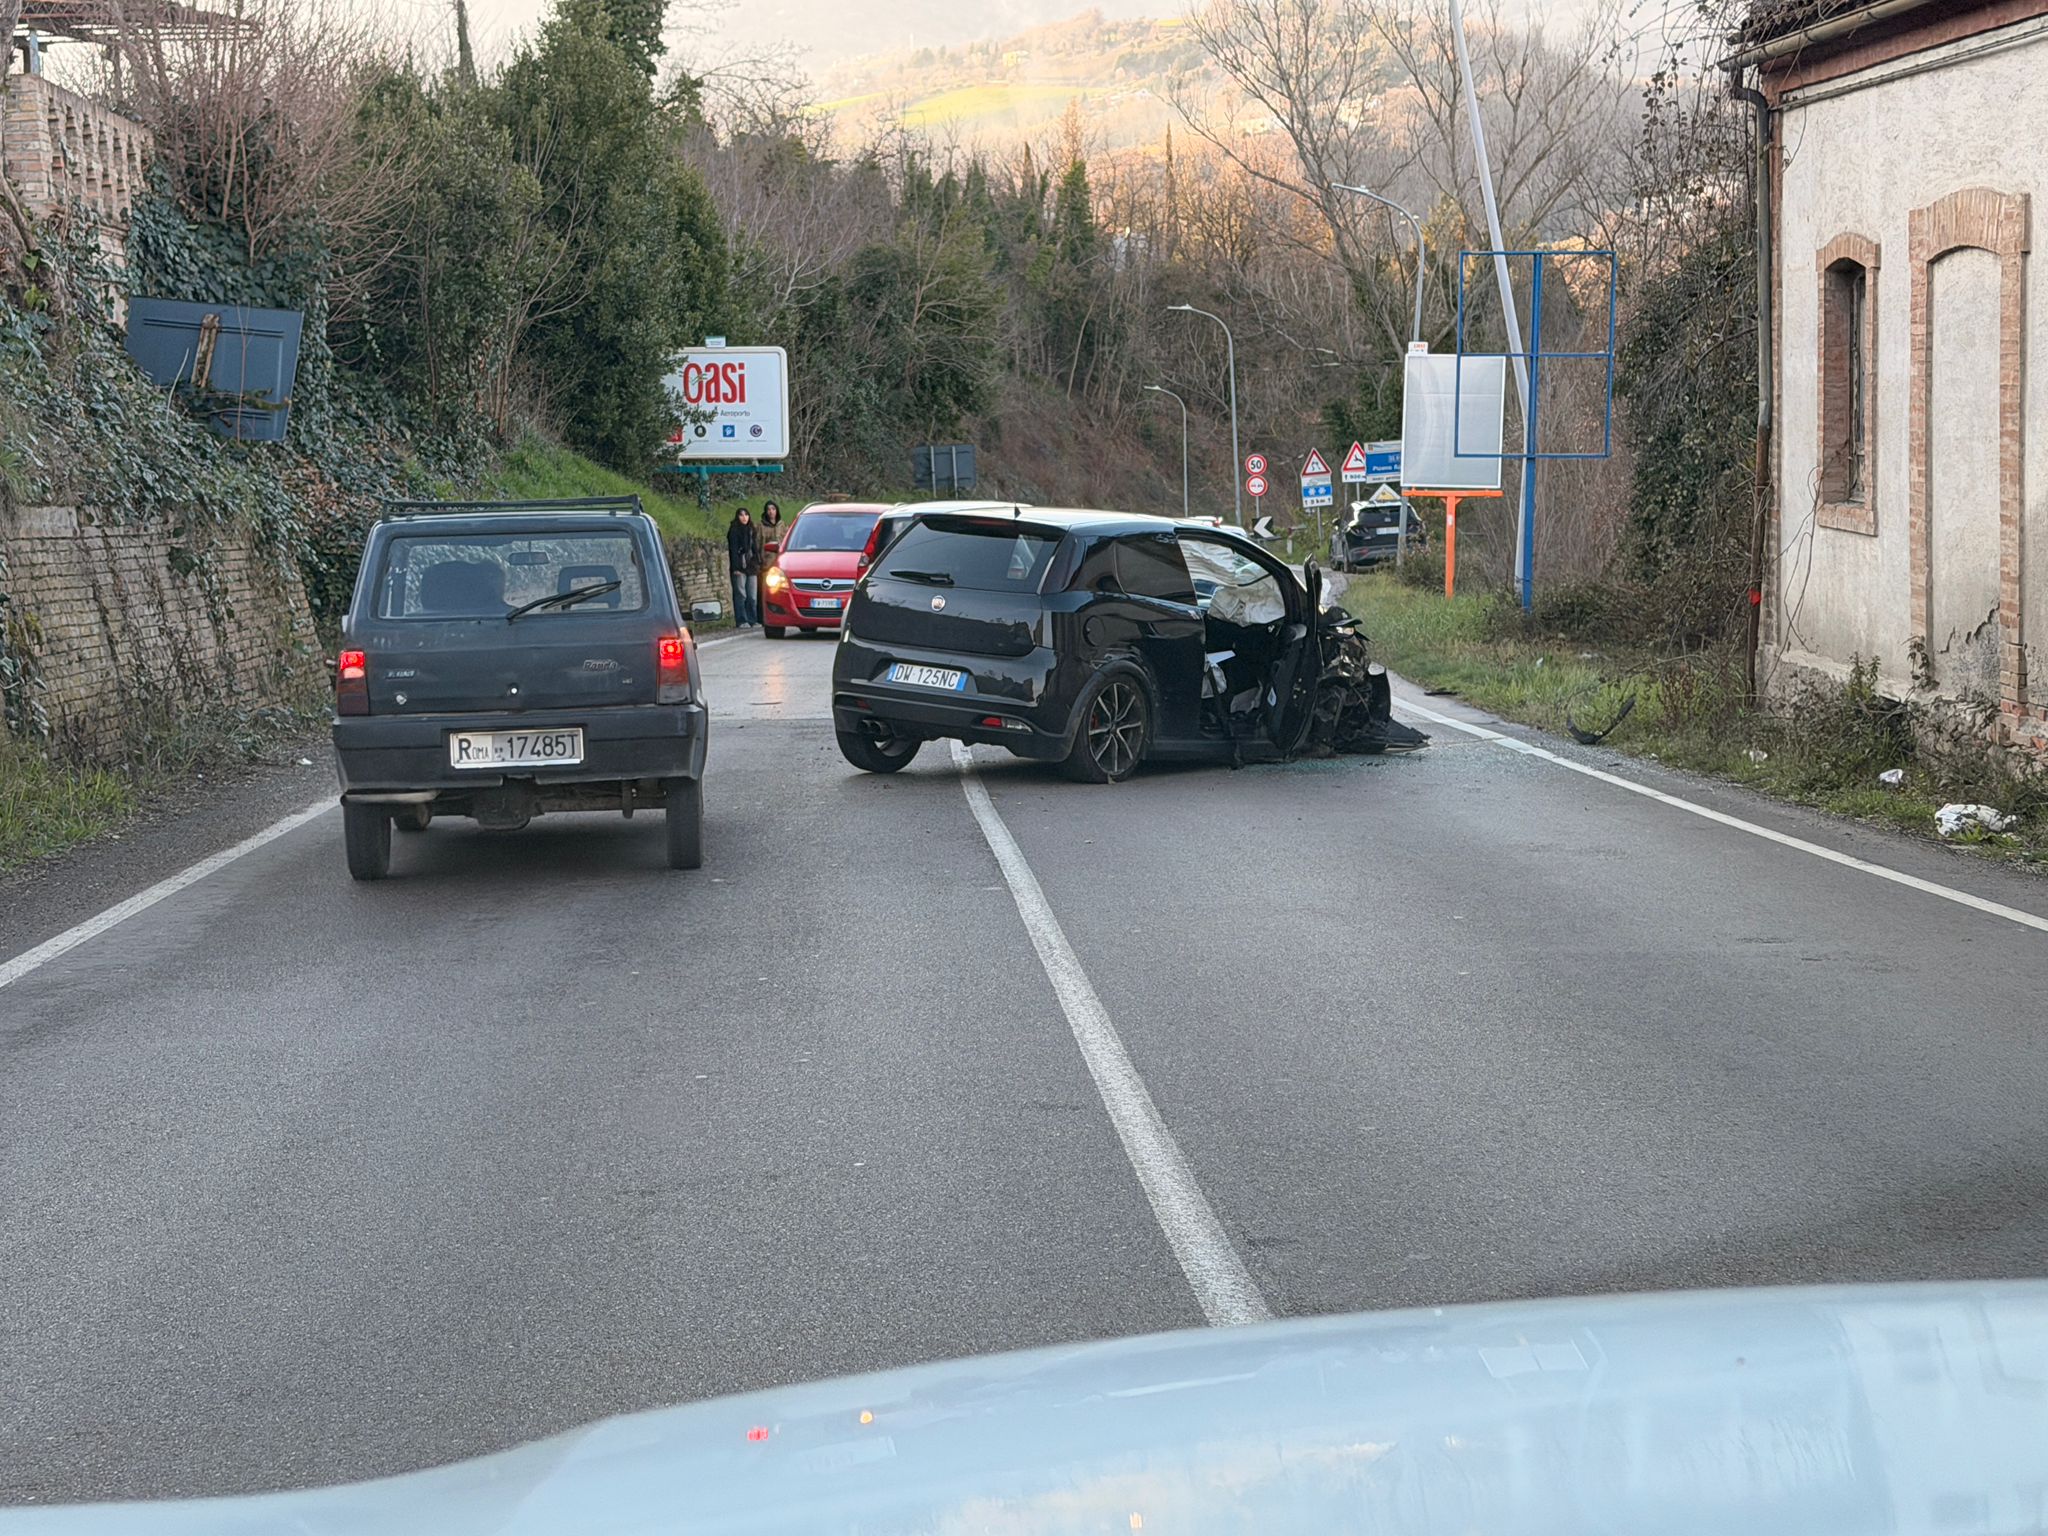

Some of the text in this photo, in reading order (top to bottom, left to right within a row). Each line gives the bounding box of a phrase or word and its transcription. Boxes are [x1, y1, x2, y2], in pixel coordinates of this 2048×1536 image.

[1250, 460, 1262, 470] 50
[895, 665, 959, 688] DW 125NC
